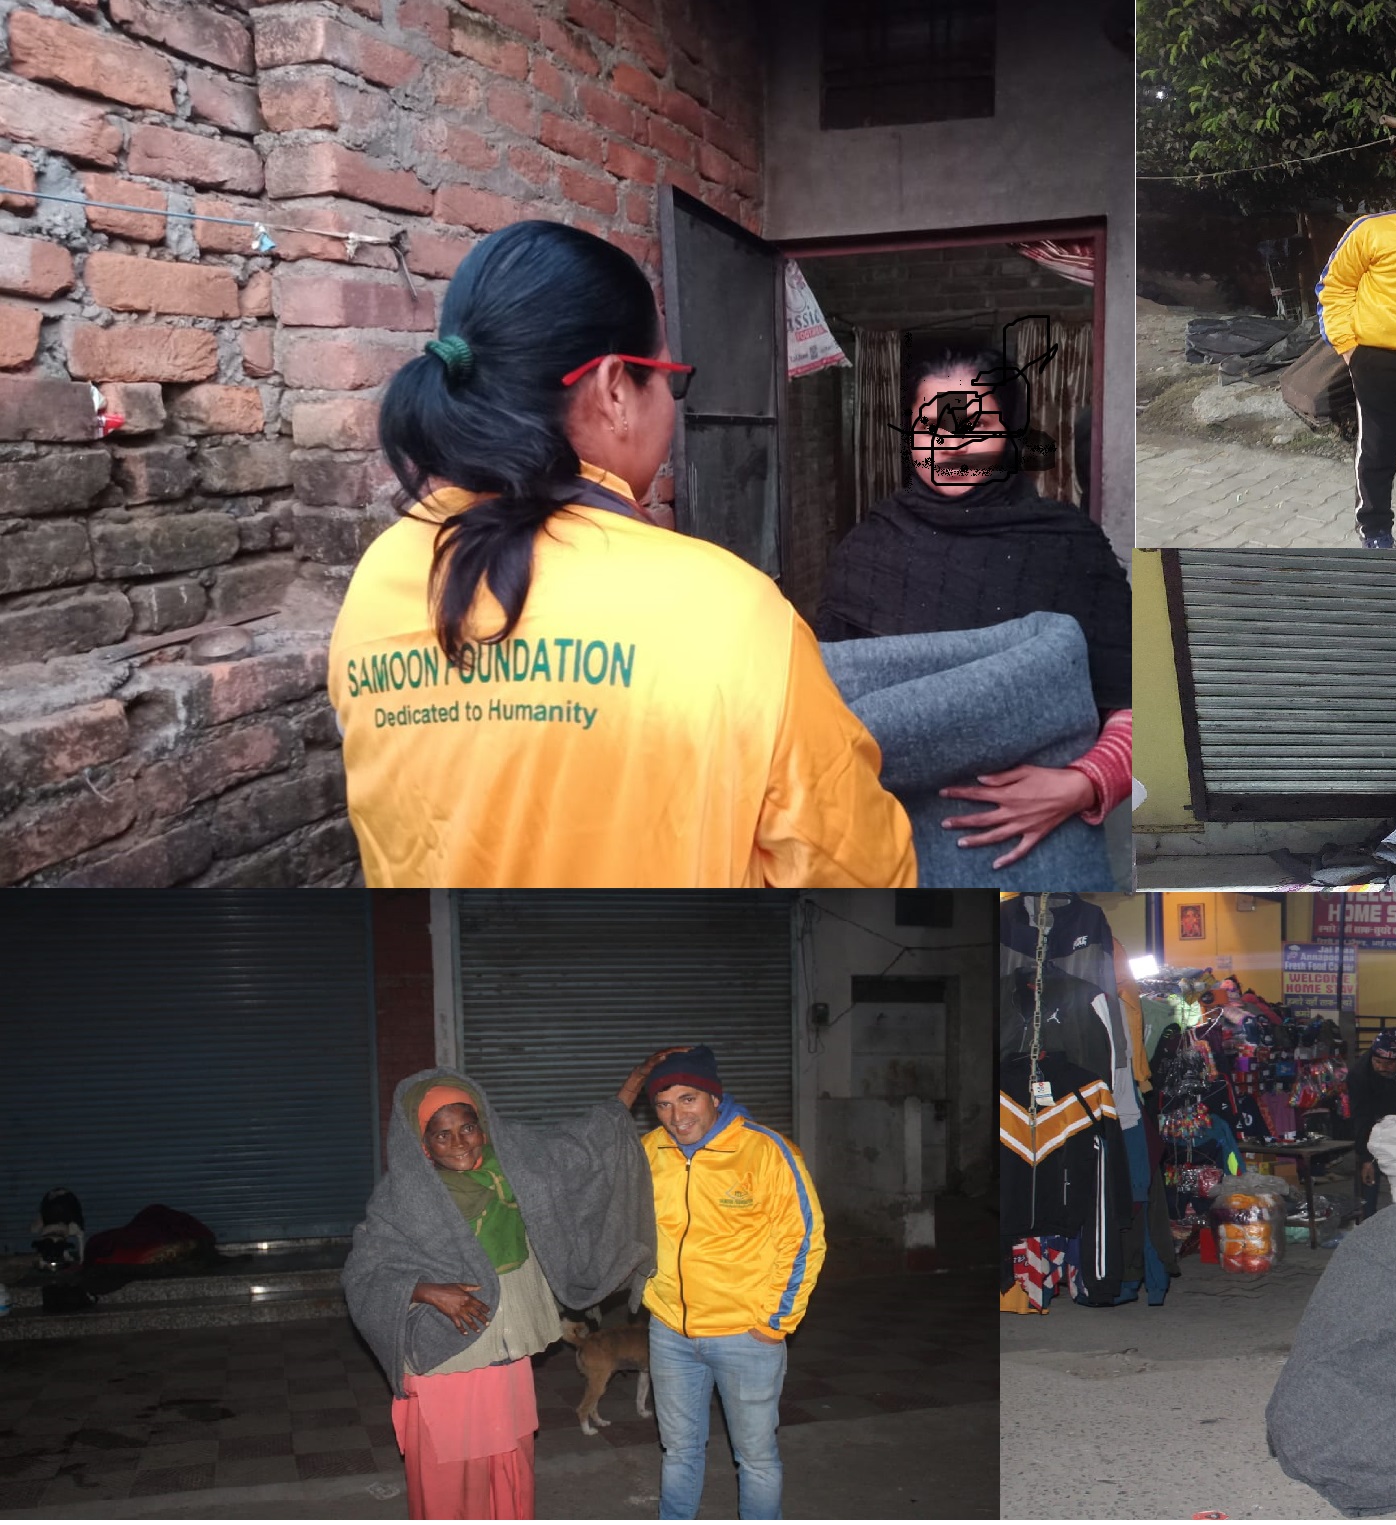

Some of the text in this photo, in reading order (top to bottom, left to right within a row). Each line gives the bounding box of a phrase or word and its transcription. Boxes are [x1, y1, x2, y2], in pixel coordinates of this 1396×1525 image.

[348, 646, 439, 698] SAMOON
[375, 699, 598, 730] Dedicated to Humanity
[1328, 903, 1382, 923] HOME
[1328, 962, 1355, 972] Coner
[1286, 983, 1322, 993] HOME
